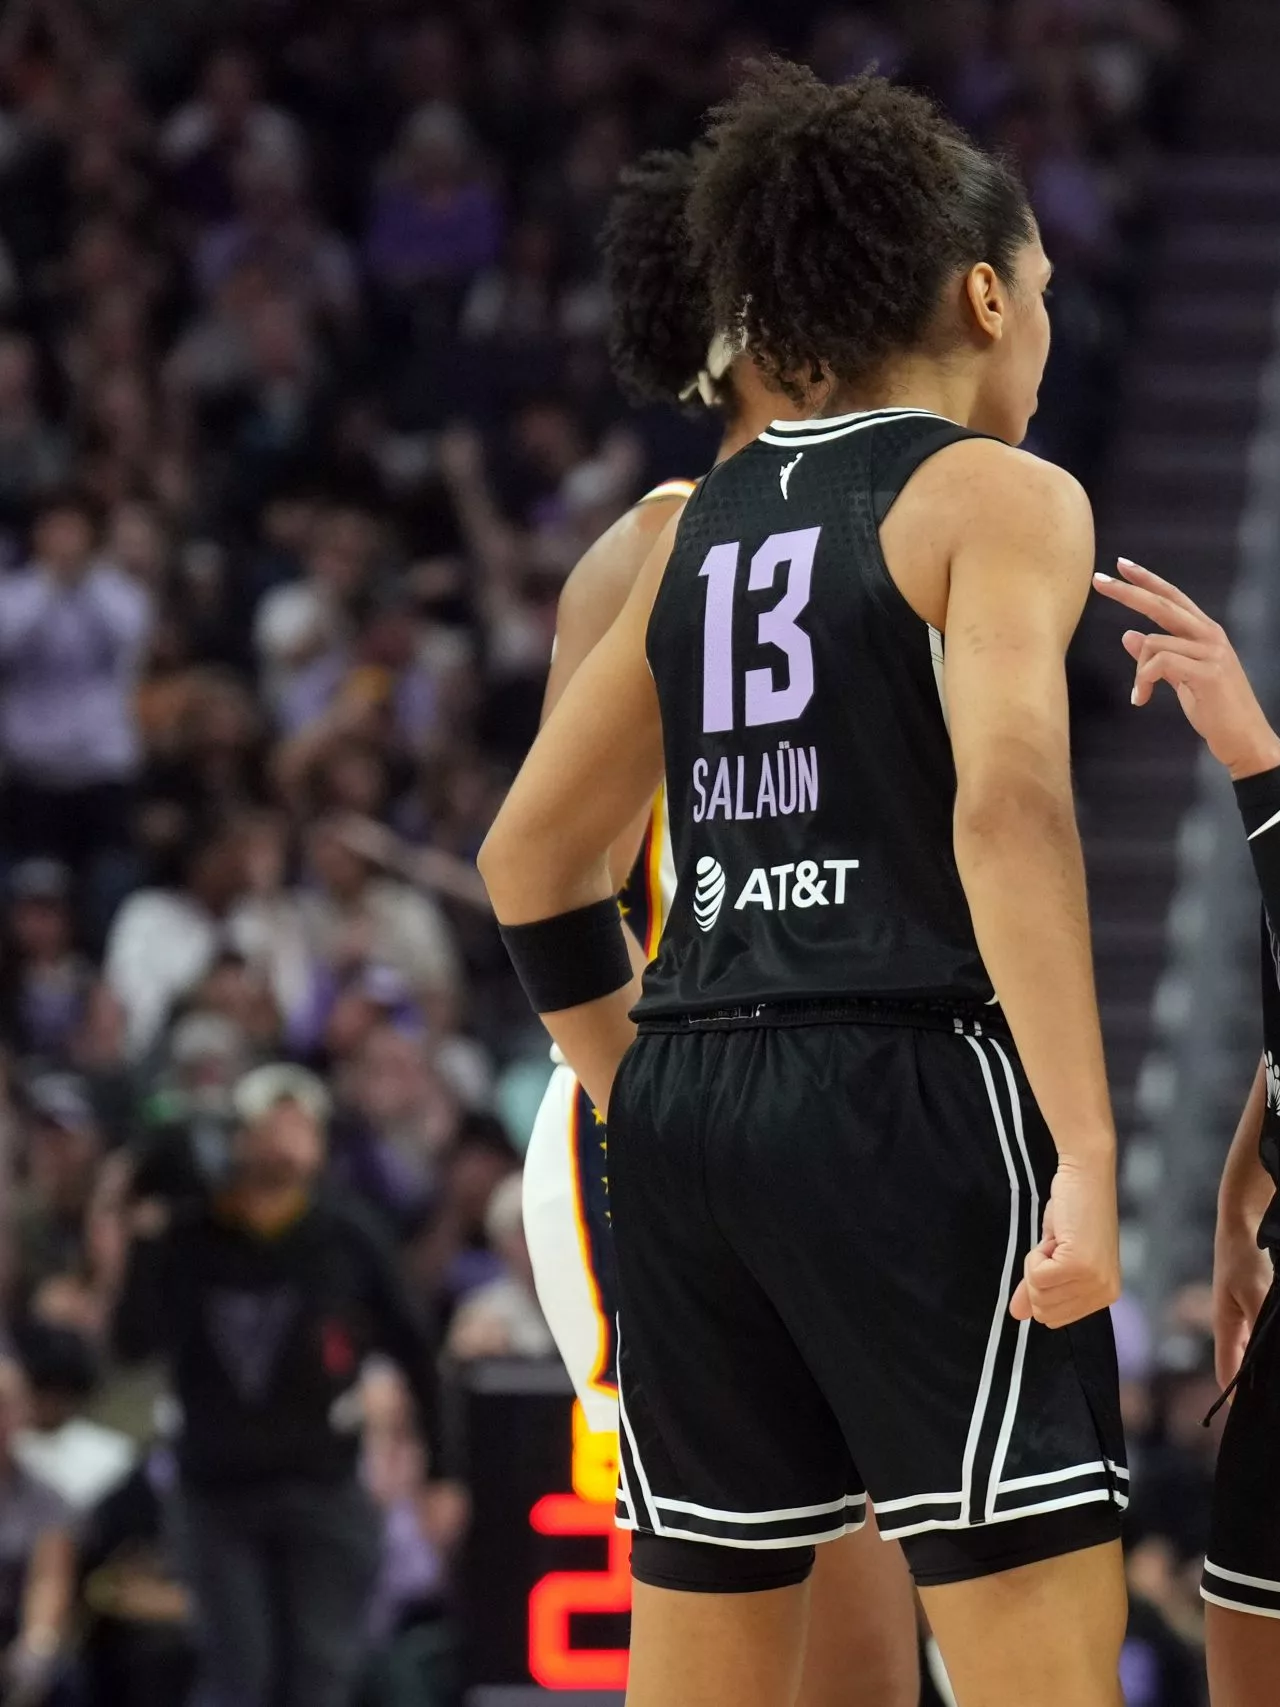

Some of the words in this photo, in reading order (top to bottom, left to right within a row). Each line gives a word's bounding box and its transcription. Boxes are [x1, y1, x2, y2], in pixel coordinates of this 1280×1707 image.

[698, 526, 822, 734] 13
[692, 741, 819, 823] SALAÜN
[734, 859, 859, 911] AT&T
